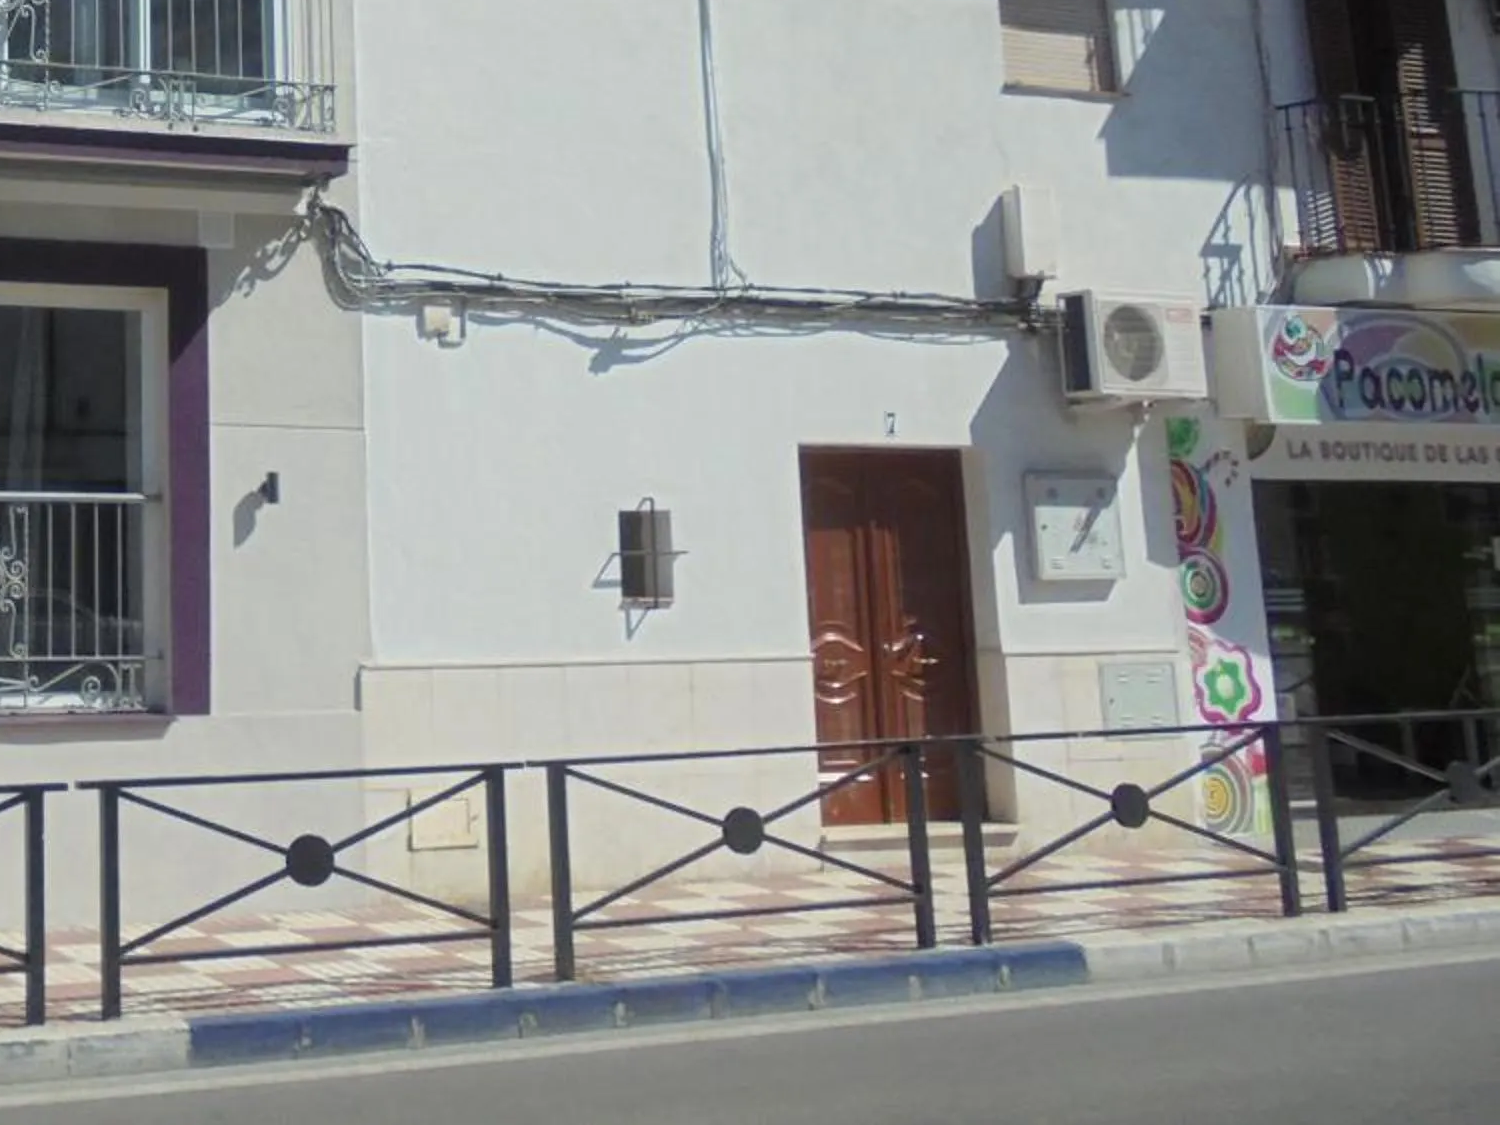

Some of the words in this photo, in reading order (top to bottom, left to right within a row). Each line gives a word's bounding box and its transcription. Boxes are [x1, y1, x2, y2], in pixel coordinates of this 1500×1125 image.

[1287, 440, 1312, 459] LA
[1319, 440, 1418, 463] BOUTIQUE
[1424, 442, 1448, 463] DE
[1455, 444, 1489, 465] LAS
